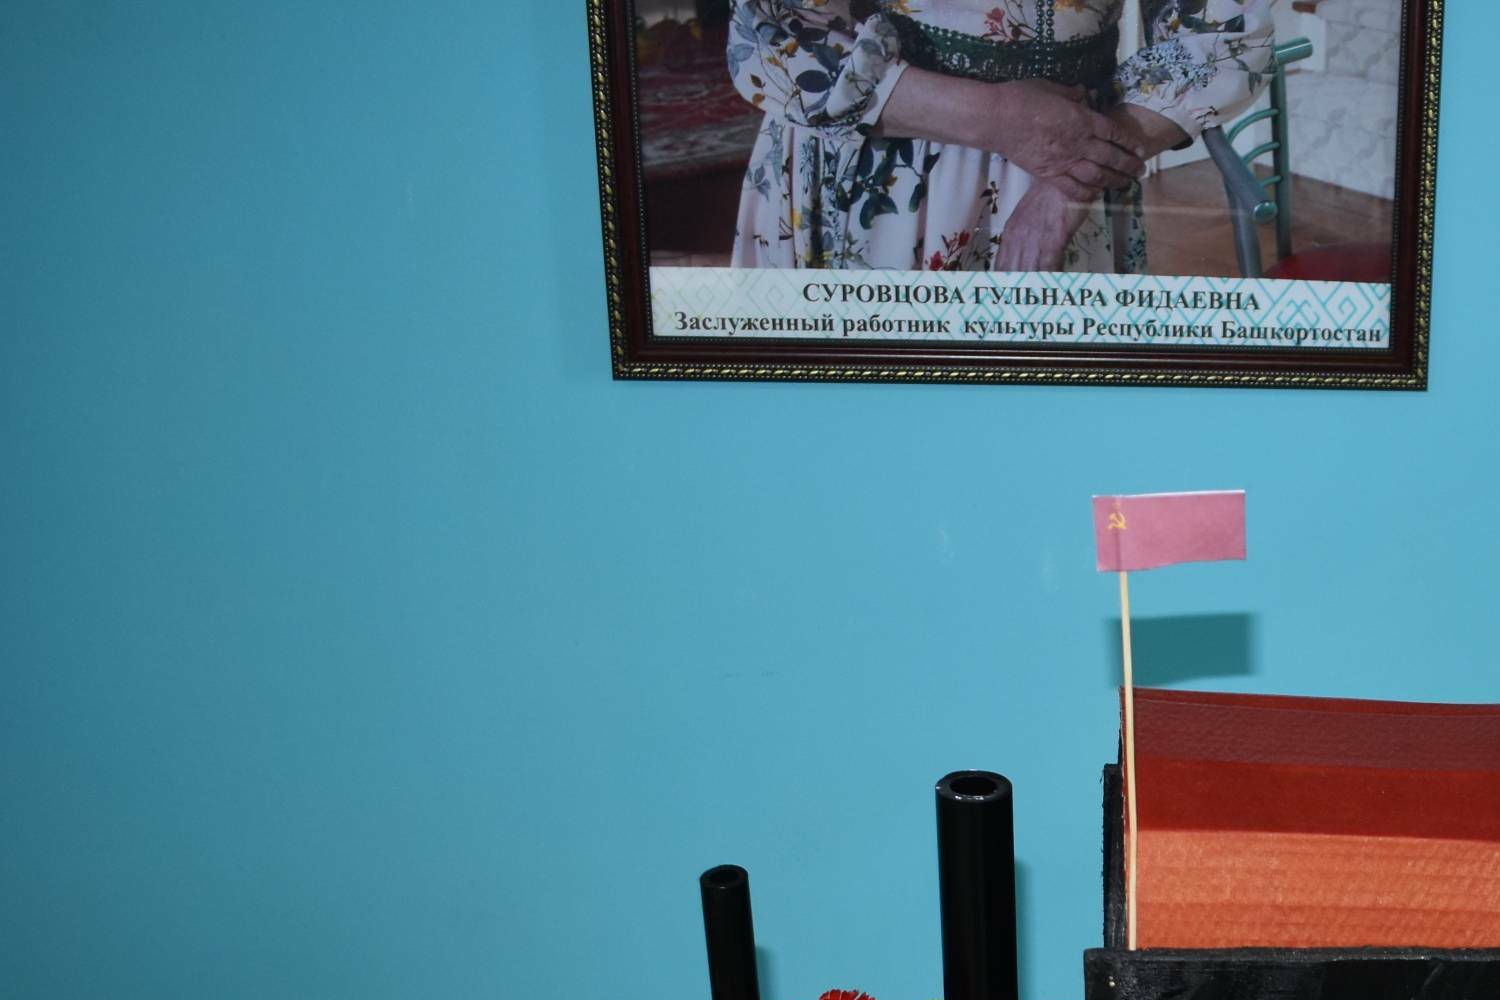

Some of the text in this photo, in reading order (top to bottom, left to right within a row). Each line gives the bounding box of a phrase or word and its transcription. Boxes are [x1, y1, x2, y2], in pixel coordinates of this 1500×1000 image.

[803, 283, 1261, 311] СУРОВЦОВА ГУЛЬНАРА ФИДАЕВНА
[674, 311, 1381, 344] Заслуженный работник культуры Республики Башкортостан
